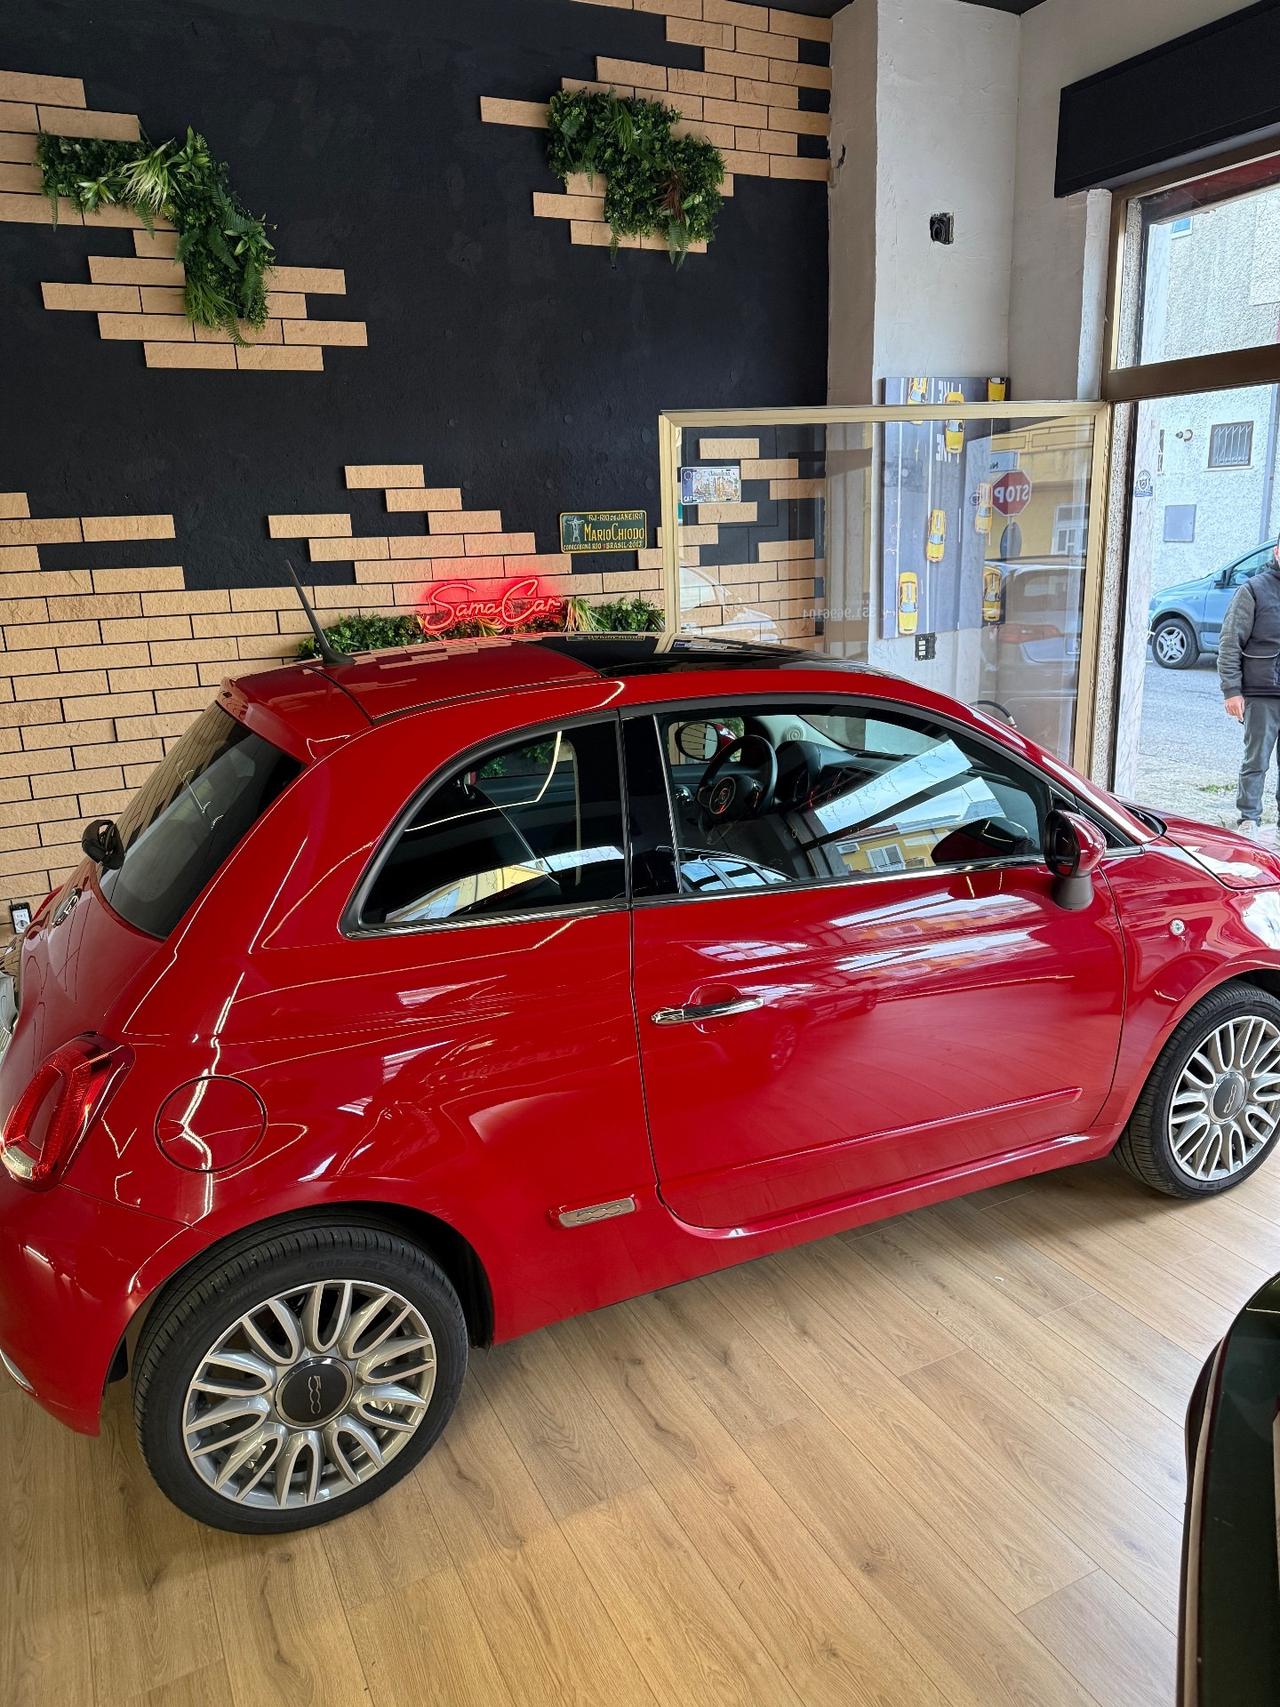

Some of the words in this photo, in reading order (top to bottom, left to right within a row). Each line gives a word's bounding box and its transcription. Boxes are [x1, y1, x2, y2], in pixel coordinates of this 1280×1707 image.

[617, 512, 643, 521] JANEIRO
[424, 582, 502, 629] Sama
[502, 579, 561, 623] Car
